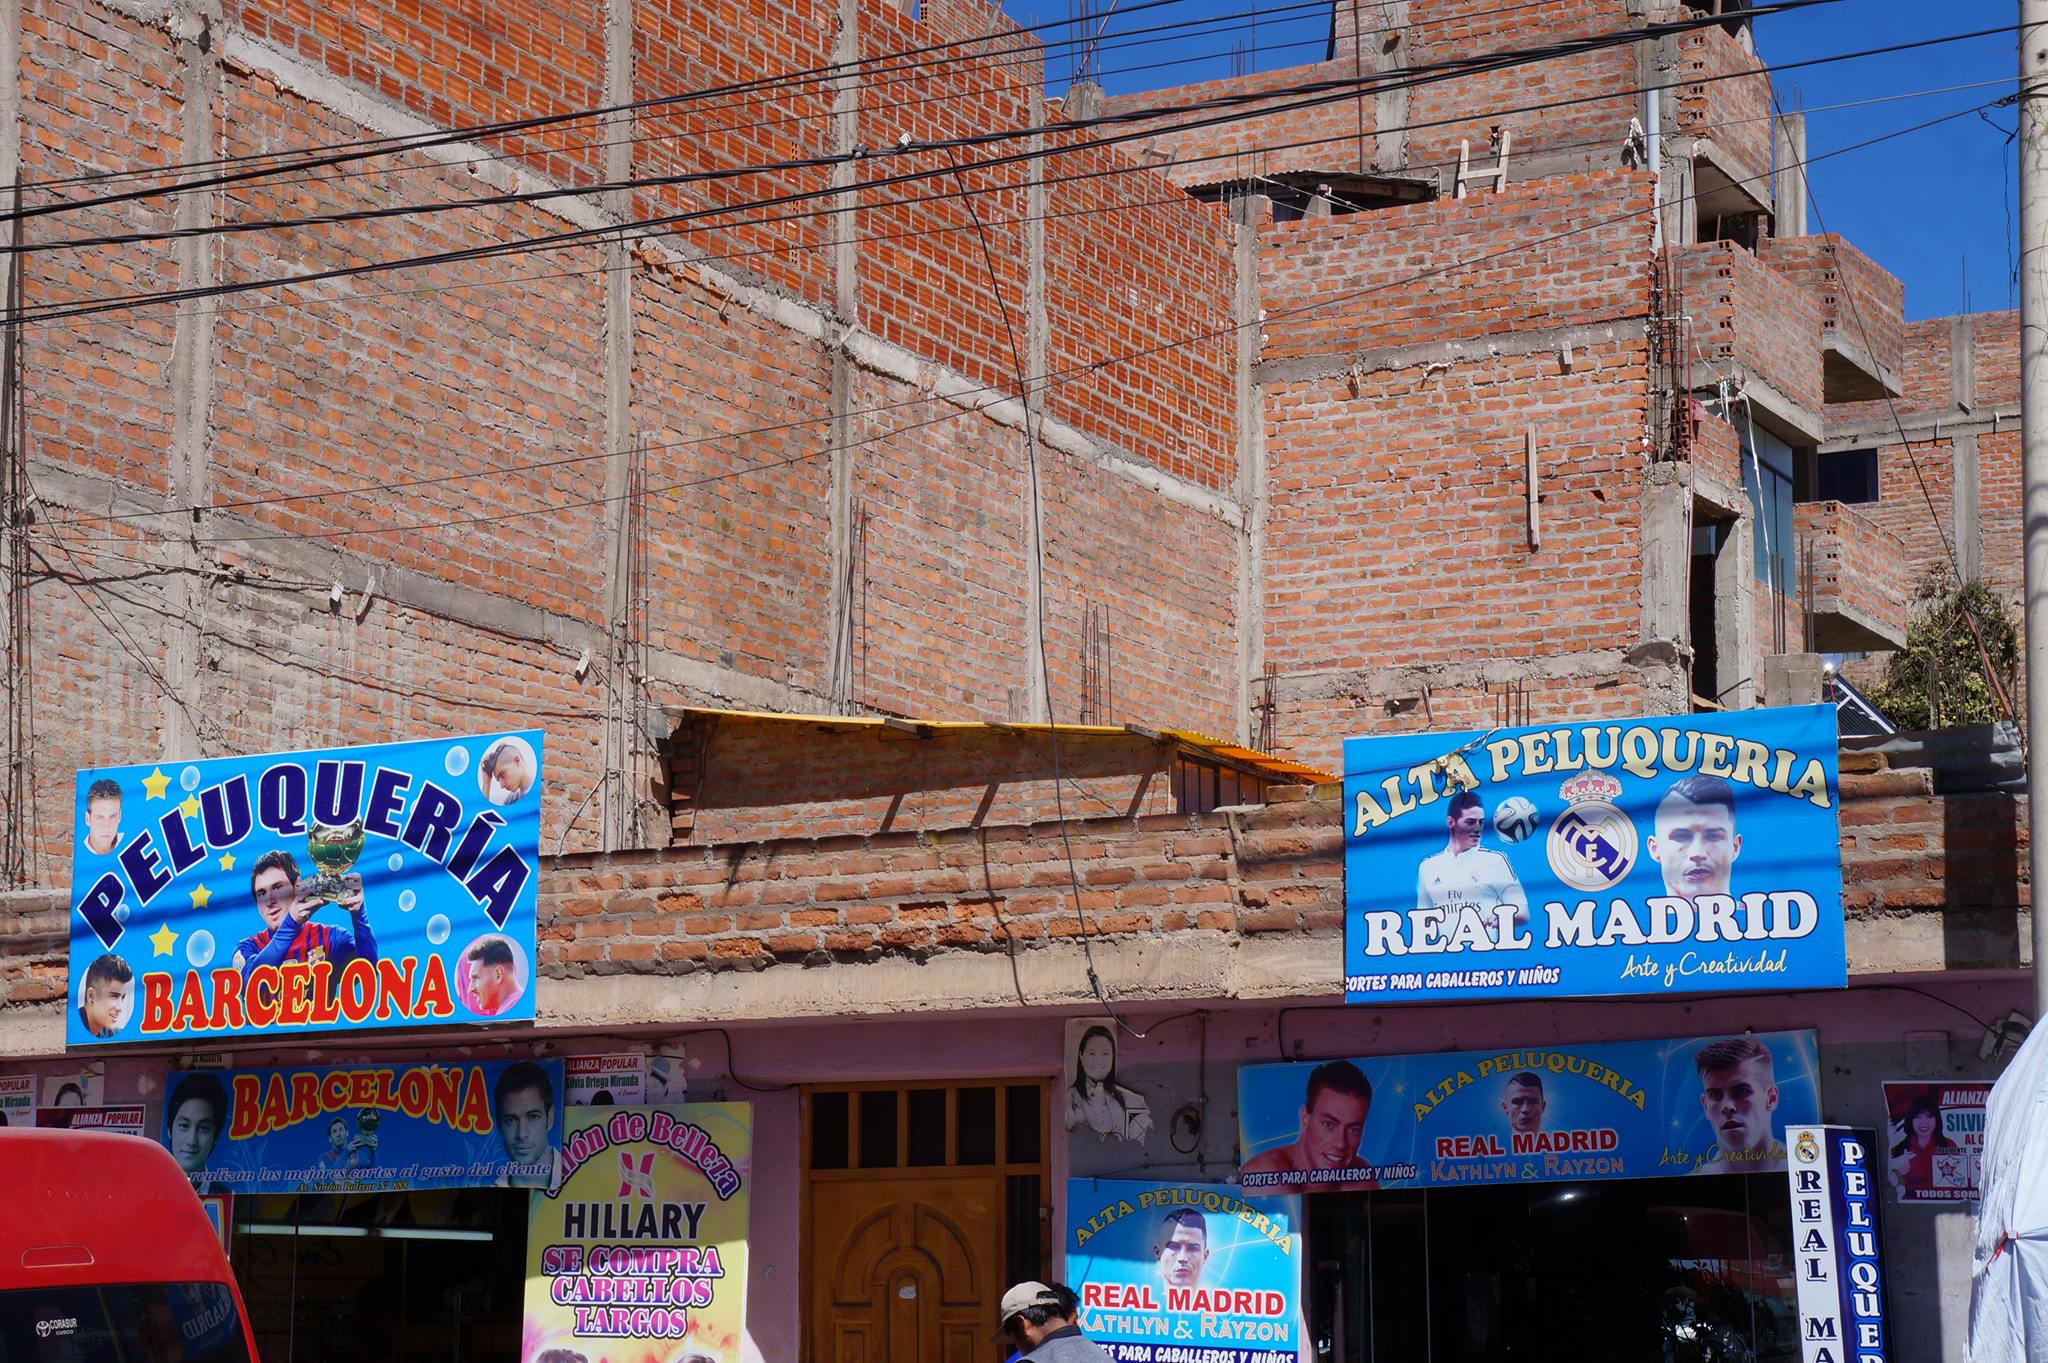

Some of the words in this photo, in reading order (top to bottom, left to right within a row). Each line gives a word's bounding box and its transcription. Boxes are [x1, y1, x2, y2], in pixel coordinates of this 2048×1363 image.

[1353, 757, 1480, 838] ALTA
[1486, 726, 1833, 809] PELUQUERIA
[78, 760, 530, 951] PELUQUERÍA
[1434, 901, 1481, 914] mirates
[1448, 890, 1462, 899] Fly
[1364, 905, 1532, 956] REAL
[1545, 891, 1820, 948] MADRID
[1390, 973, 1422, 990] PARA
[1426, 970, 1504, 989] CABALLEROS
[1506, 970, 1516, 986] Y
[1518, 966, 1559, 985] NIÑOS
[1620, 955, 1659, 980] Arte
[1664, 963, 1676, 987] y
[1675, 950, 1787, 976] Creatividad
[140, 953, 454, 1034] BARCELONA
[567, 1059, 600, 1072] ALIANZA
[601, 1058, 638, 1069] POPULAR
[566, 1076, 584, 1088] Silvia
[586, 1076, 609, 1089] Ortega
[610, 1074, 638, 1087] Miranda
[1412, 1069, 1472, 1123] ALTA
[1477, 1051, 1647, 1111] PELUQUERIA
[72, 1113, 103, 1126] ALIANZA
[107, 1112, 140, 1125] POPULAR
[229, 1067, 494, 1141] BARCELONA
[611, 1113, 646, 1143] de
[1436, 1133, 1505, 1158] REAL
[1511, 1130, 1618, 1154] MADRID
[191, 1167, 256, 1182] realizan
[258, 1167, 284, 1182] los
[285, 1166, 347, 1186] mejores
[350, 1166, 396, 1179] cortes
[400, 1164, 418, 1177] al
[419, 1163, 464, 1181] gusto
[467, 1162, 493, 1177] del
[497, 1161, 550, 1177] cliente
[1242, 1171, 1278, 1186] CORTES
[1281, 1170, 1307, 1185] PARA
[1309, 1167, 1371, 1184] CABALLEROS
[1373, 1166, 1382, 1181] Y
[1384, 1163, 1416, 1180] NIÑOS
[1430, 1160, 1516, 1182] KATHLYN
[1521, 1162, 1539, 1179] &
[1543, 1154, 1624, 1176] RAYZON
[1658, 1147, 1690, 1166] Arte
[1695, 1154, 1705, 1173] y
[1915, 1189, 1951, 1199] TODOS
[563, 1203, 706, 1239] HILLARY
[1075, 1200, 1135, 1248] ALTA
[1137, 1189, 1293, 1256] PELUQUERIA
[1796, 1170, 1829, 1282] REAL
[543, 1246, 582, 1276] SE
[589, 1246, 723, 1277] COMPRA
[551, 1276, 713, 1306] CABELLOS
[1084, 1285, 1158, 1310] REAL
[1168, 1289, 1284, 1315] MADRID
[50, 1318, 77, 1329] CORASUR
[573, 1306, 687, 1337] LARGOS
[1078, 1309, 1169, 1336] KATHLYN
[1174, 1320, 1193, 1339] &
[1201, 1314, 1289, 1341] RAYZON
[1118, 1345, 1149, 1362] PARA
[1154, 1346, 1236, 1363] CABALLEROS
[1239, 1349, 1248, 1363] Y
[1249, 1349, 1294, 1363] NIÑOS
